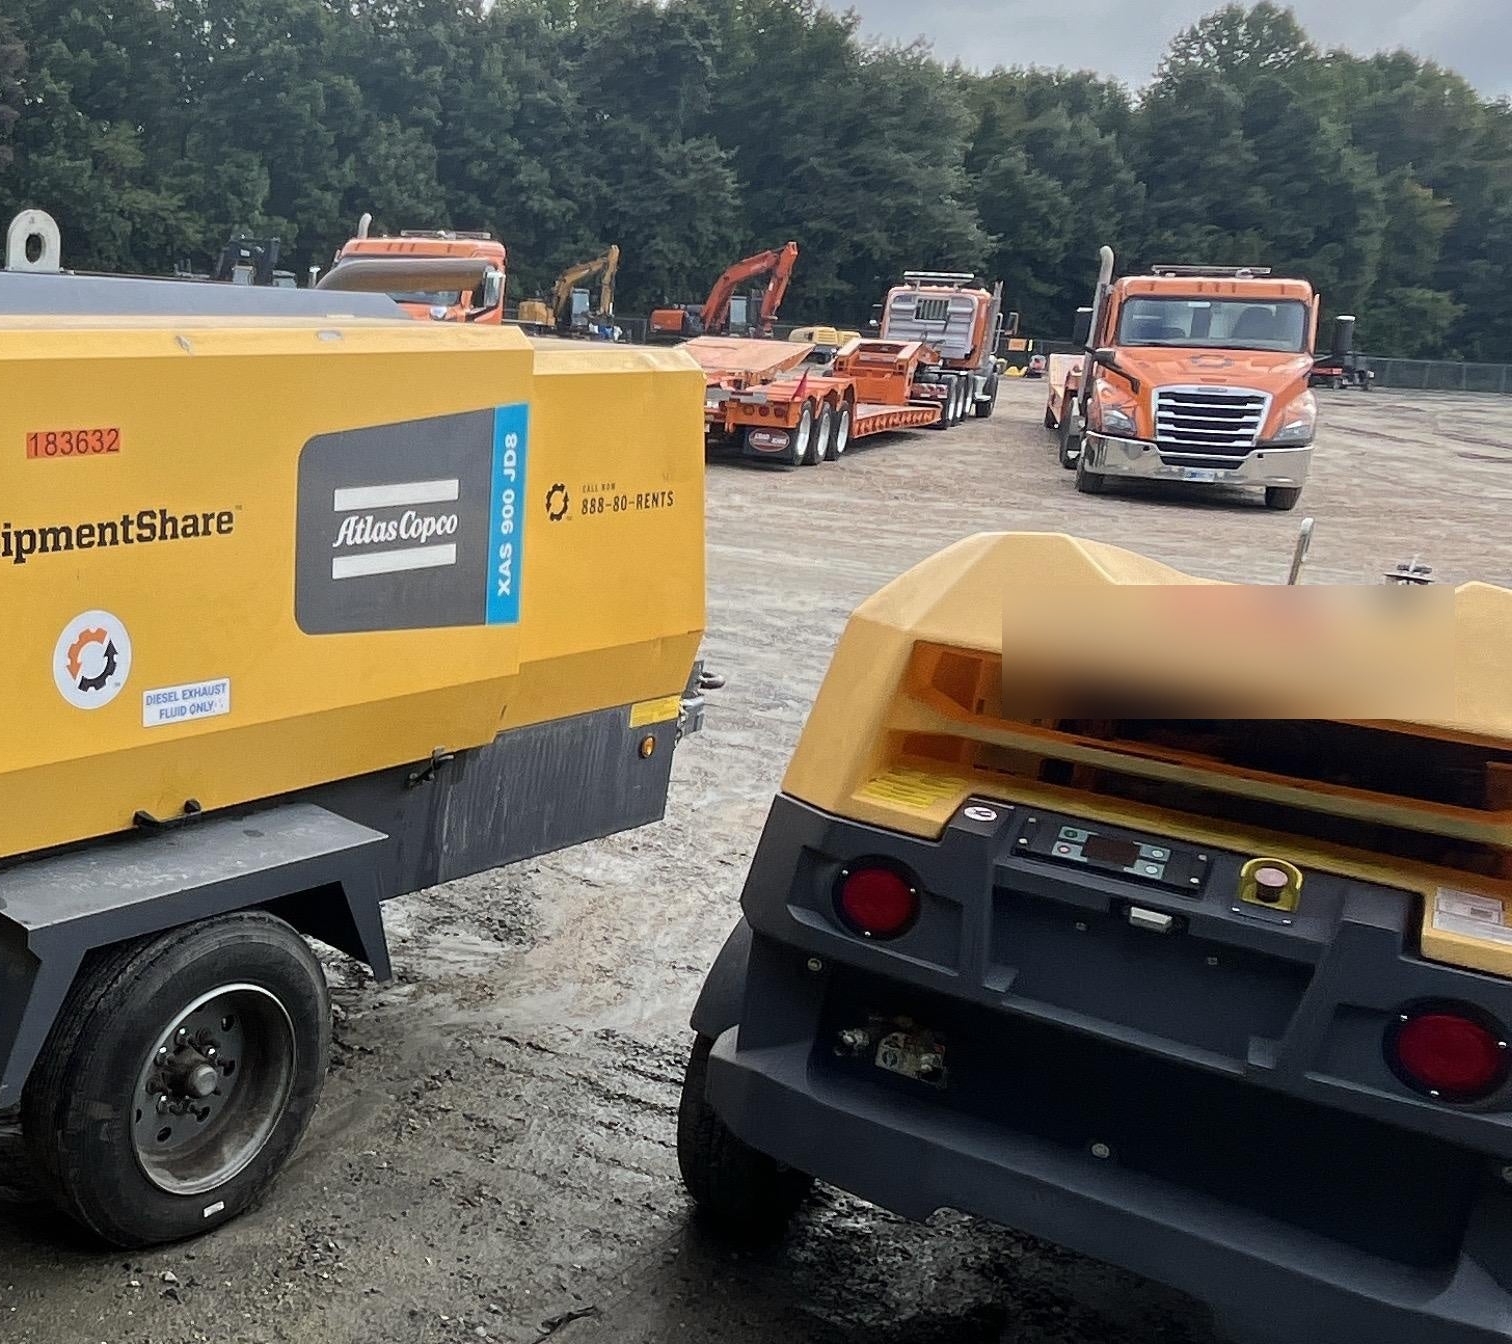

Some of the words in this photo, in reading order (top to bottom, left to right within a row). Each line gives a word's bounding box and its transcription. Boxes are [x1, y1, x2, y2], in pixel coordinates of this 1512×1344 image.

[29, 427, 120, 457] 183632
[503, 431, 518, 483] JD8
[580, 490, 675, 516] 888-80-RENTS
[582, 484, 599, 494] CALL
[501, 488, 516, 535] 900
[497, 542, 513, 597] XAS
[145, 690, 179, 706] DIESEL
[181, 682, 227, 701] EXHAUST
[159, 705, 188, 721] FLUID
[189, 700, 215, 716] ONLY
